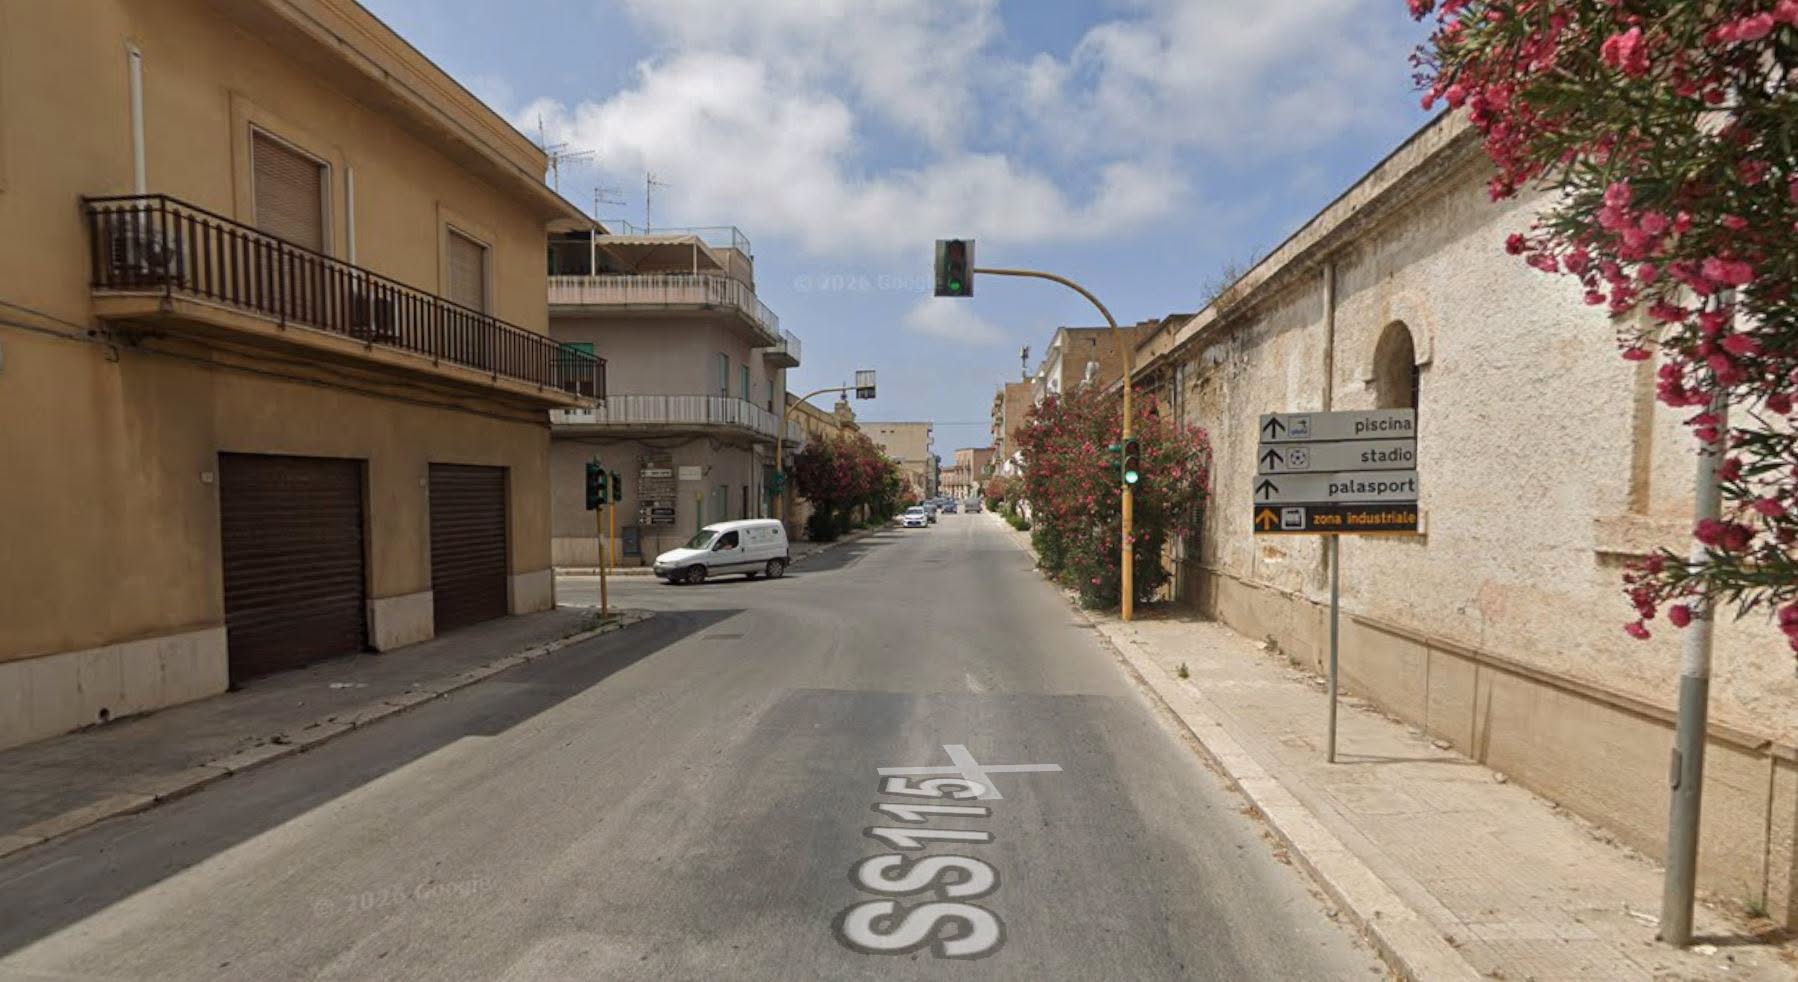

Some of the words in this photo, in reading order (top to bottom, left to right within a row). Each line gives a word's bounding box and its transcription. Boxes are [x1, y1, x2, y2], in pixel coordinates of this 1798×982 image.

[1355, 417, 1412, 434] piscina
[1361, 448, 1413, 463] stadio
[1328, 478, 1415, 496] palasport
[1312, 513, 1343, 525] zona
[1347, 511, 1417, 525] industriale
